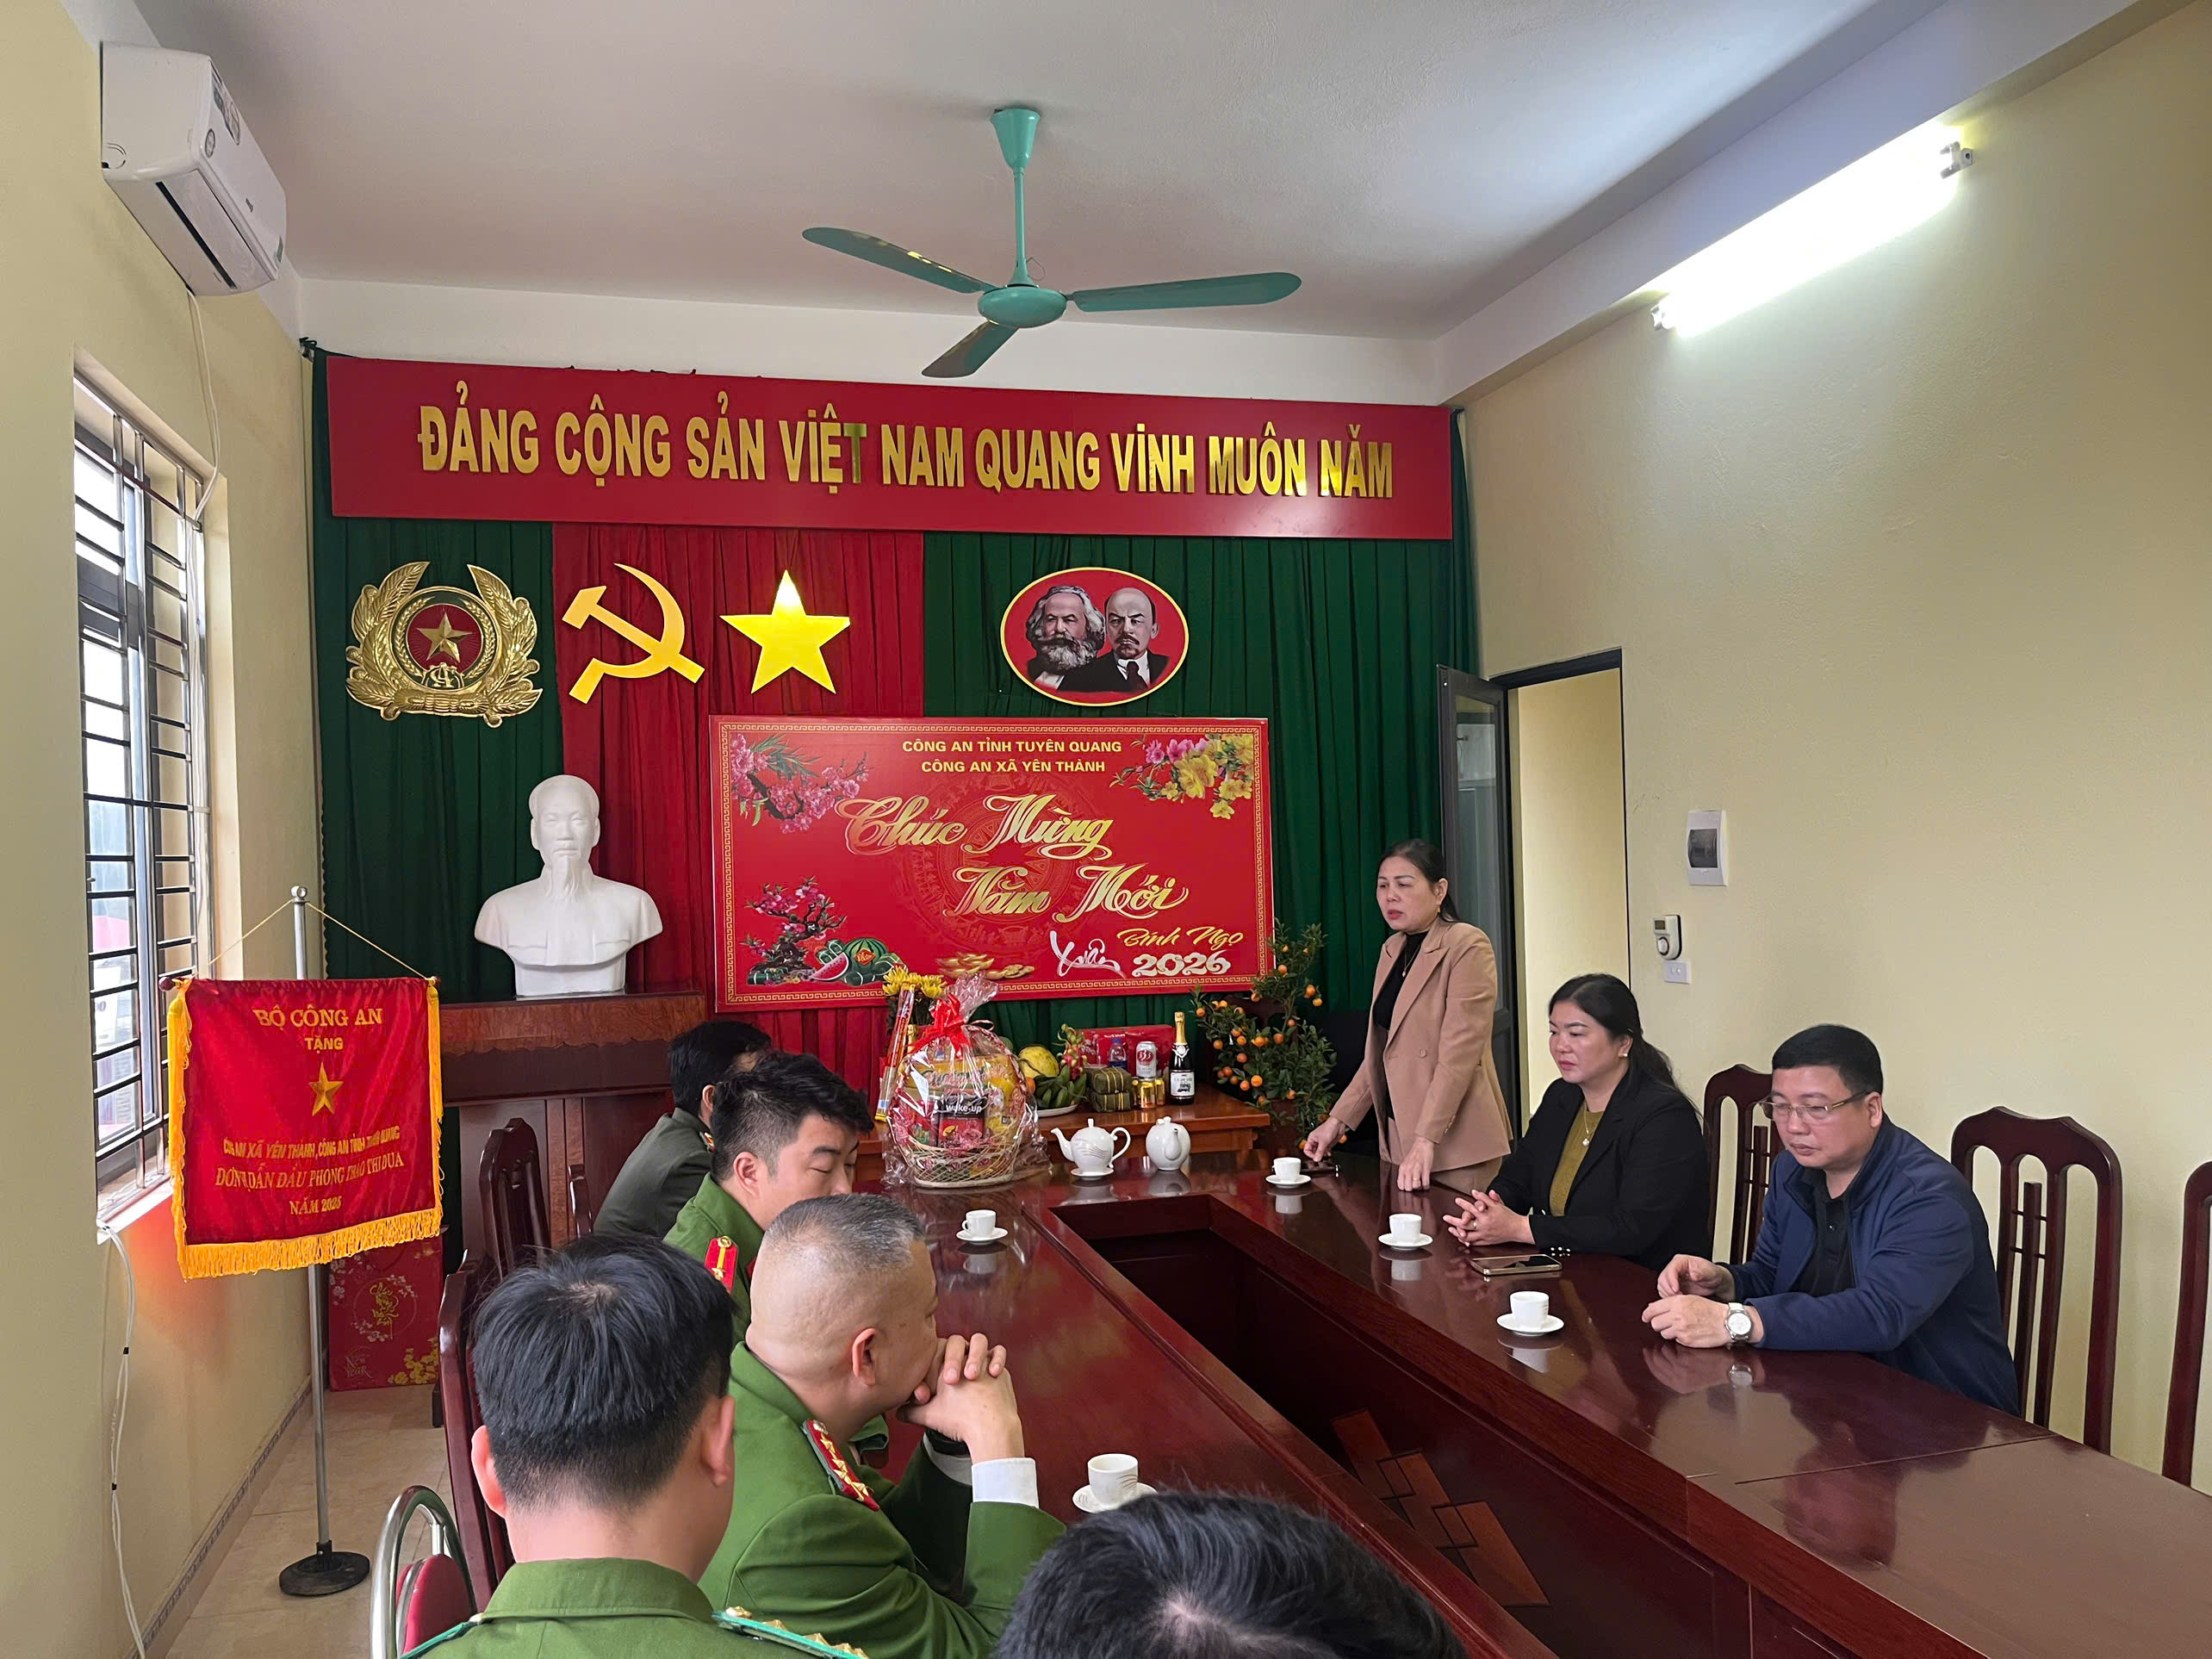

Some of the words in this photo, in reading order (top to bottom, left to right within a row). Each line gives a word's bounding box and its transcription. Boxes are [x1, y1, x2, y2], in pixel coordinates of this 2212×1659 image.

[417, 380, 539, 473] ĐẢNG
[555, 394, 672, 488] CỘNG
[687, 391, 765, 481] SẢN
[881, 423, 966, 488] NAM
[975, 428, 1100, 493] QUANG
[1209, 420, 1308, 497] MUÔN
[1320, 424, 1394, 499] NĂM
[902, 738, 947, 752] CÔNG
[951, 741, 972, 752] AN
[977, 736, 1012, 752] TỈNH
[1016, 739, 1066, 752] TUYÊN
[1069, 741, 1122, 753] QUANG
[921, 758, 966, 773] CÔNG
[969, 761, 992, 773] AN
[996, 759, 1018, 773] XÃ
[1022, 759, 1052, 773] YÊN
[1056, 760, 1105, 773] THÀNH
[834, 795, 968, 855] Chúc
[960, 793, 1115, 862] Mừng
[943, 866, 1052, 917] Năm
[1053, 862, 1190, 923] Mới
[1116, 926, 1182, 948] Bính
[1186, 926, 1244, 951] Ngọ
[1131, 950, 1232, 978] 2026
[252, 1004, 286, 1031] BỘ
[289, 1003, 349, 1028] CÔNG
[354, 1008, 383, 1026] AN
[304, 1035, 344, 1054] TẶNG
[308, 1165, 345, 1187] PHONG
